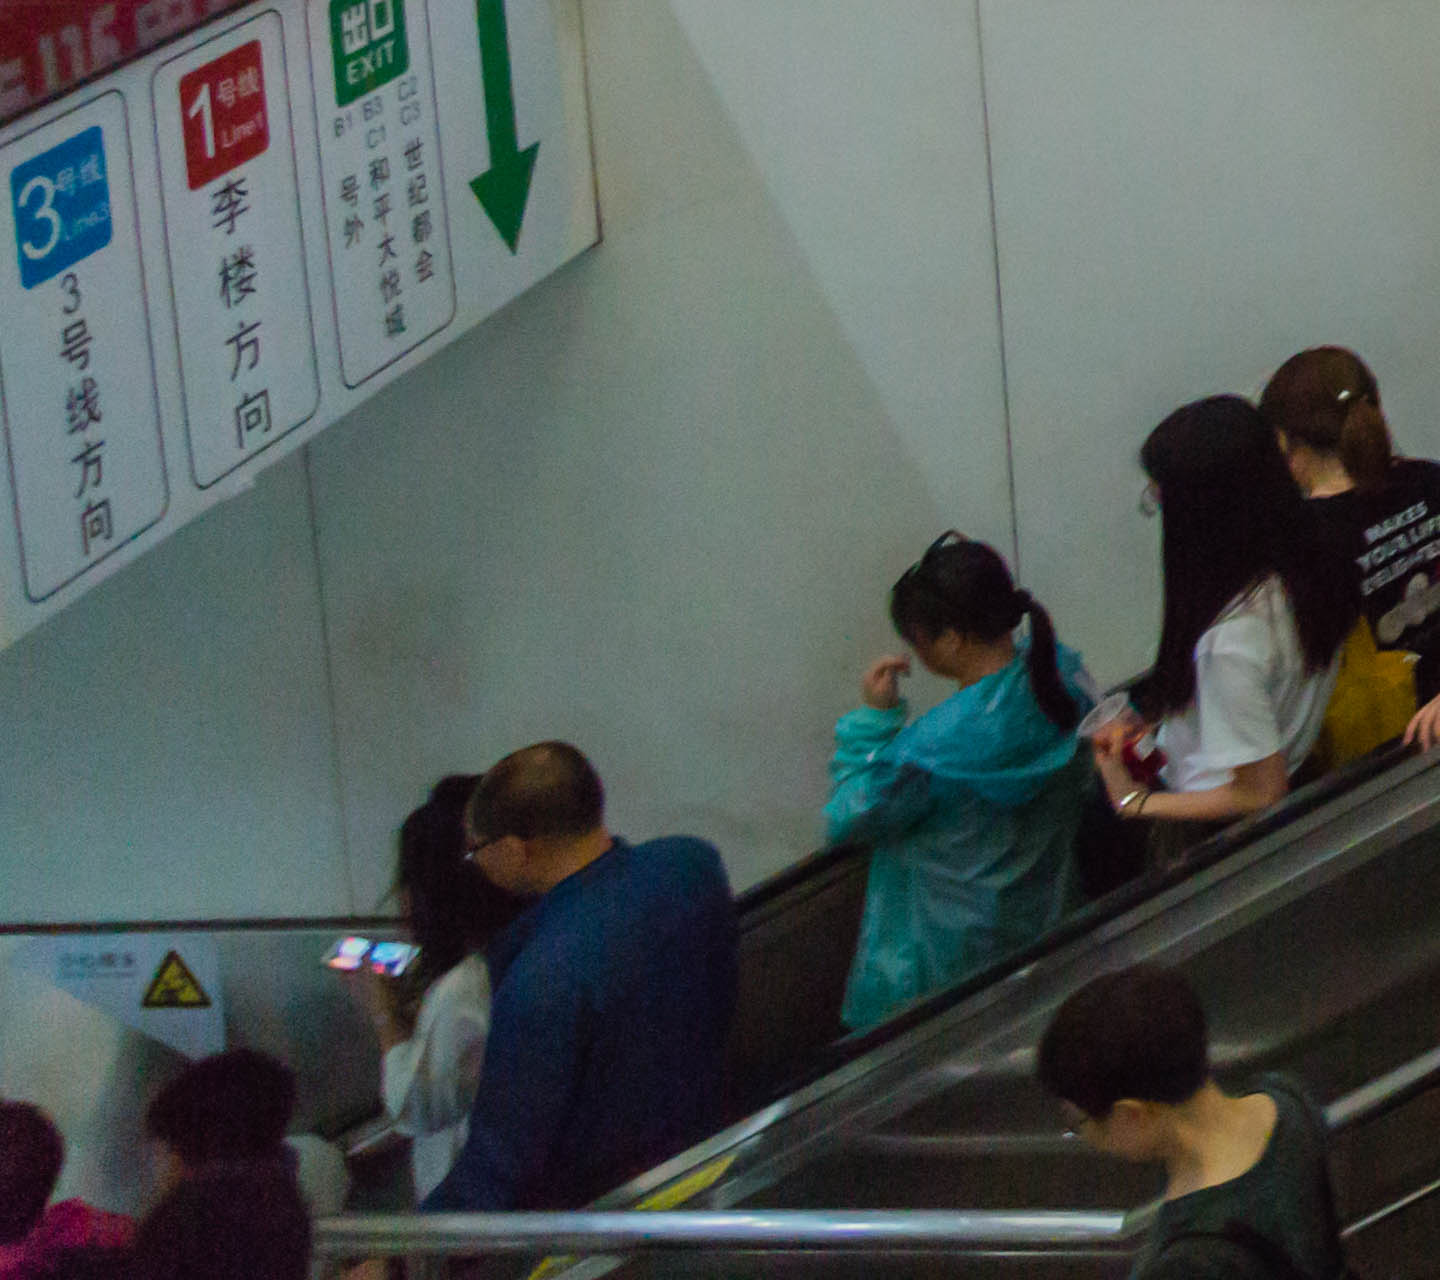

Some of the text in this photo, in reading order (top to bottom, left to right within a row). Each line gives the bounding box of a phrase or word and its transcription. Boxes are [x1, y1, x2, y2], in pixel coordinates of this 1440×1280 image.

[345, 40, 398, 86] EXIT
[189, 83, 216, 160] 1
[18, 175, 62, 261] 3
[339, 174, 365, 248] 号外
[212, 177, 273, 451] 李楼方向
[60, 272, 115, 558] 3号线方向
